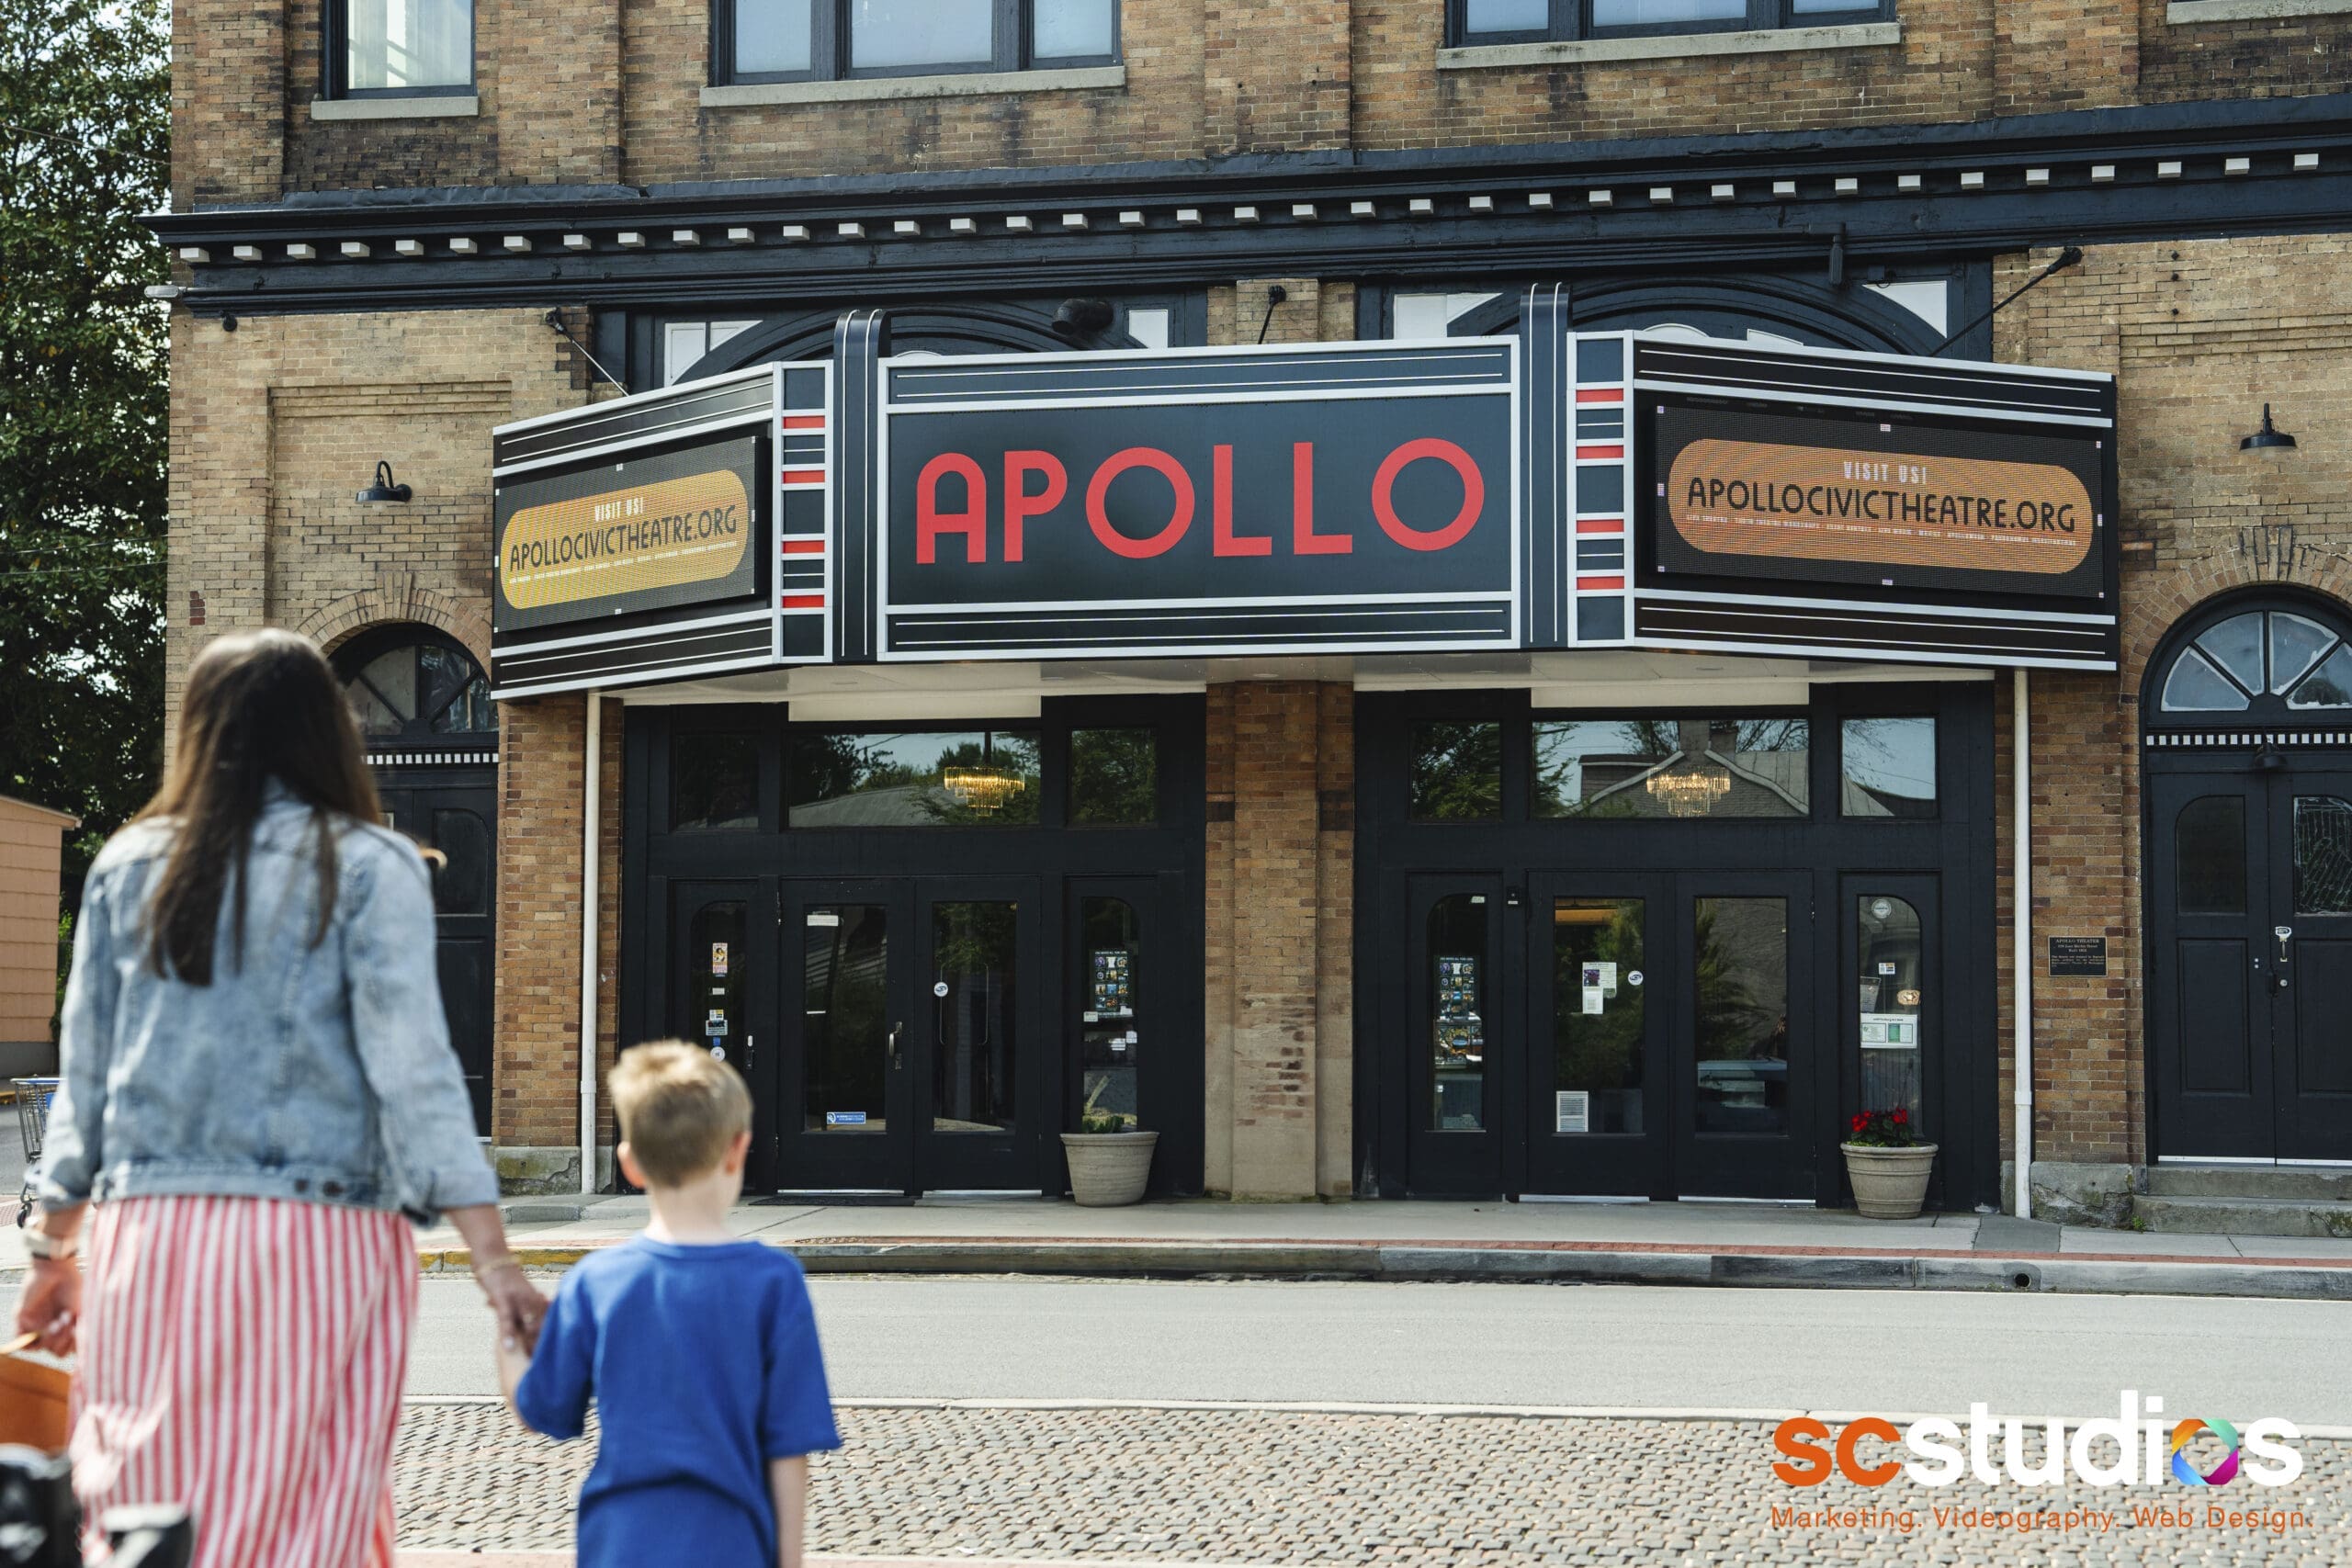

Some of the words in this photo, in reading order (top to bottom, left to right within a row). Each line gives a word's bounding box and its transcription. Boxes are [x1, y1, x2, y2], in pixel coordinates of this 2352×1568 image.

[916, 437, 1484, 564] APOLLO
[1843, 461, 1889, 482] VISIT
[1898, 464, 1927, 484] US!
[594, 502, 622, 522] VISIT
[625, 497, 644, 517] US!
[1687, 477, 2075, 533] APOLLOCIVICTHEATRE.ORG
[509, 504, 737, 572] APOLLOCIVICTHEATRE.ORG
